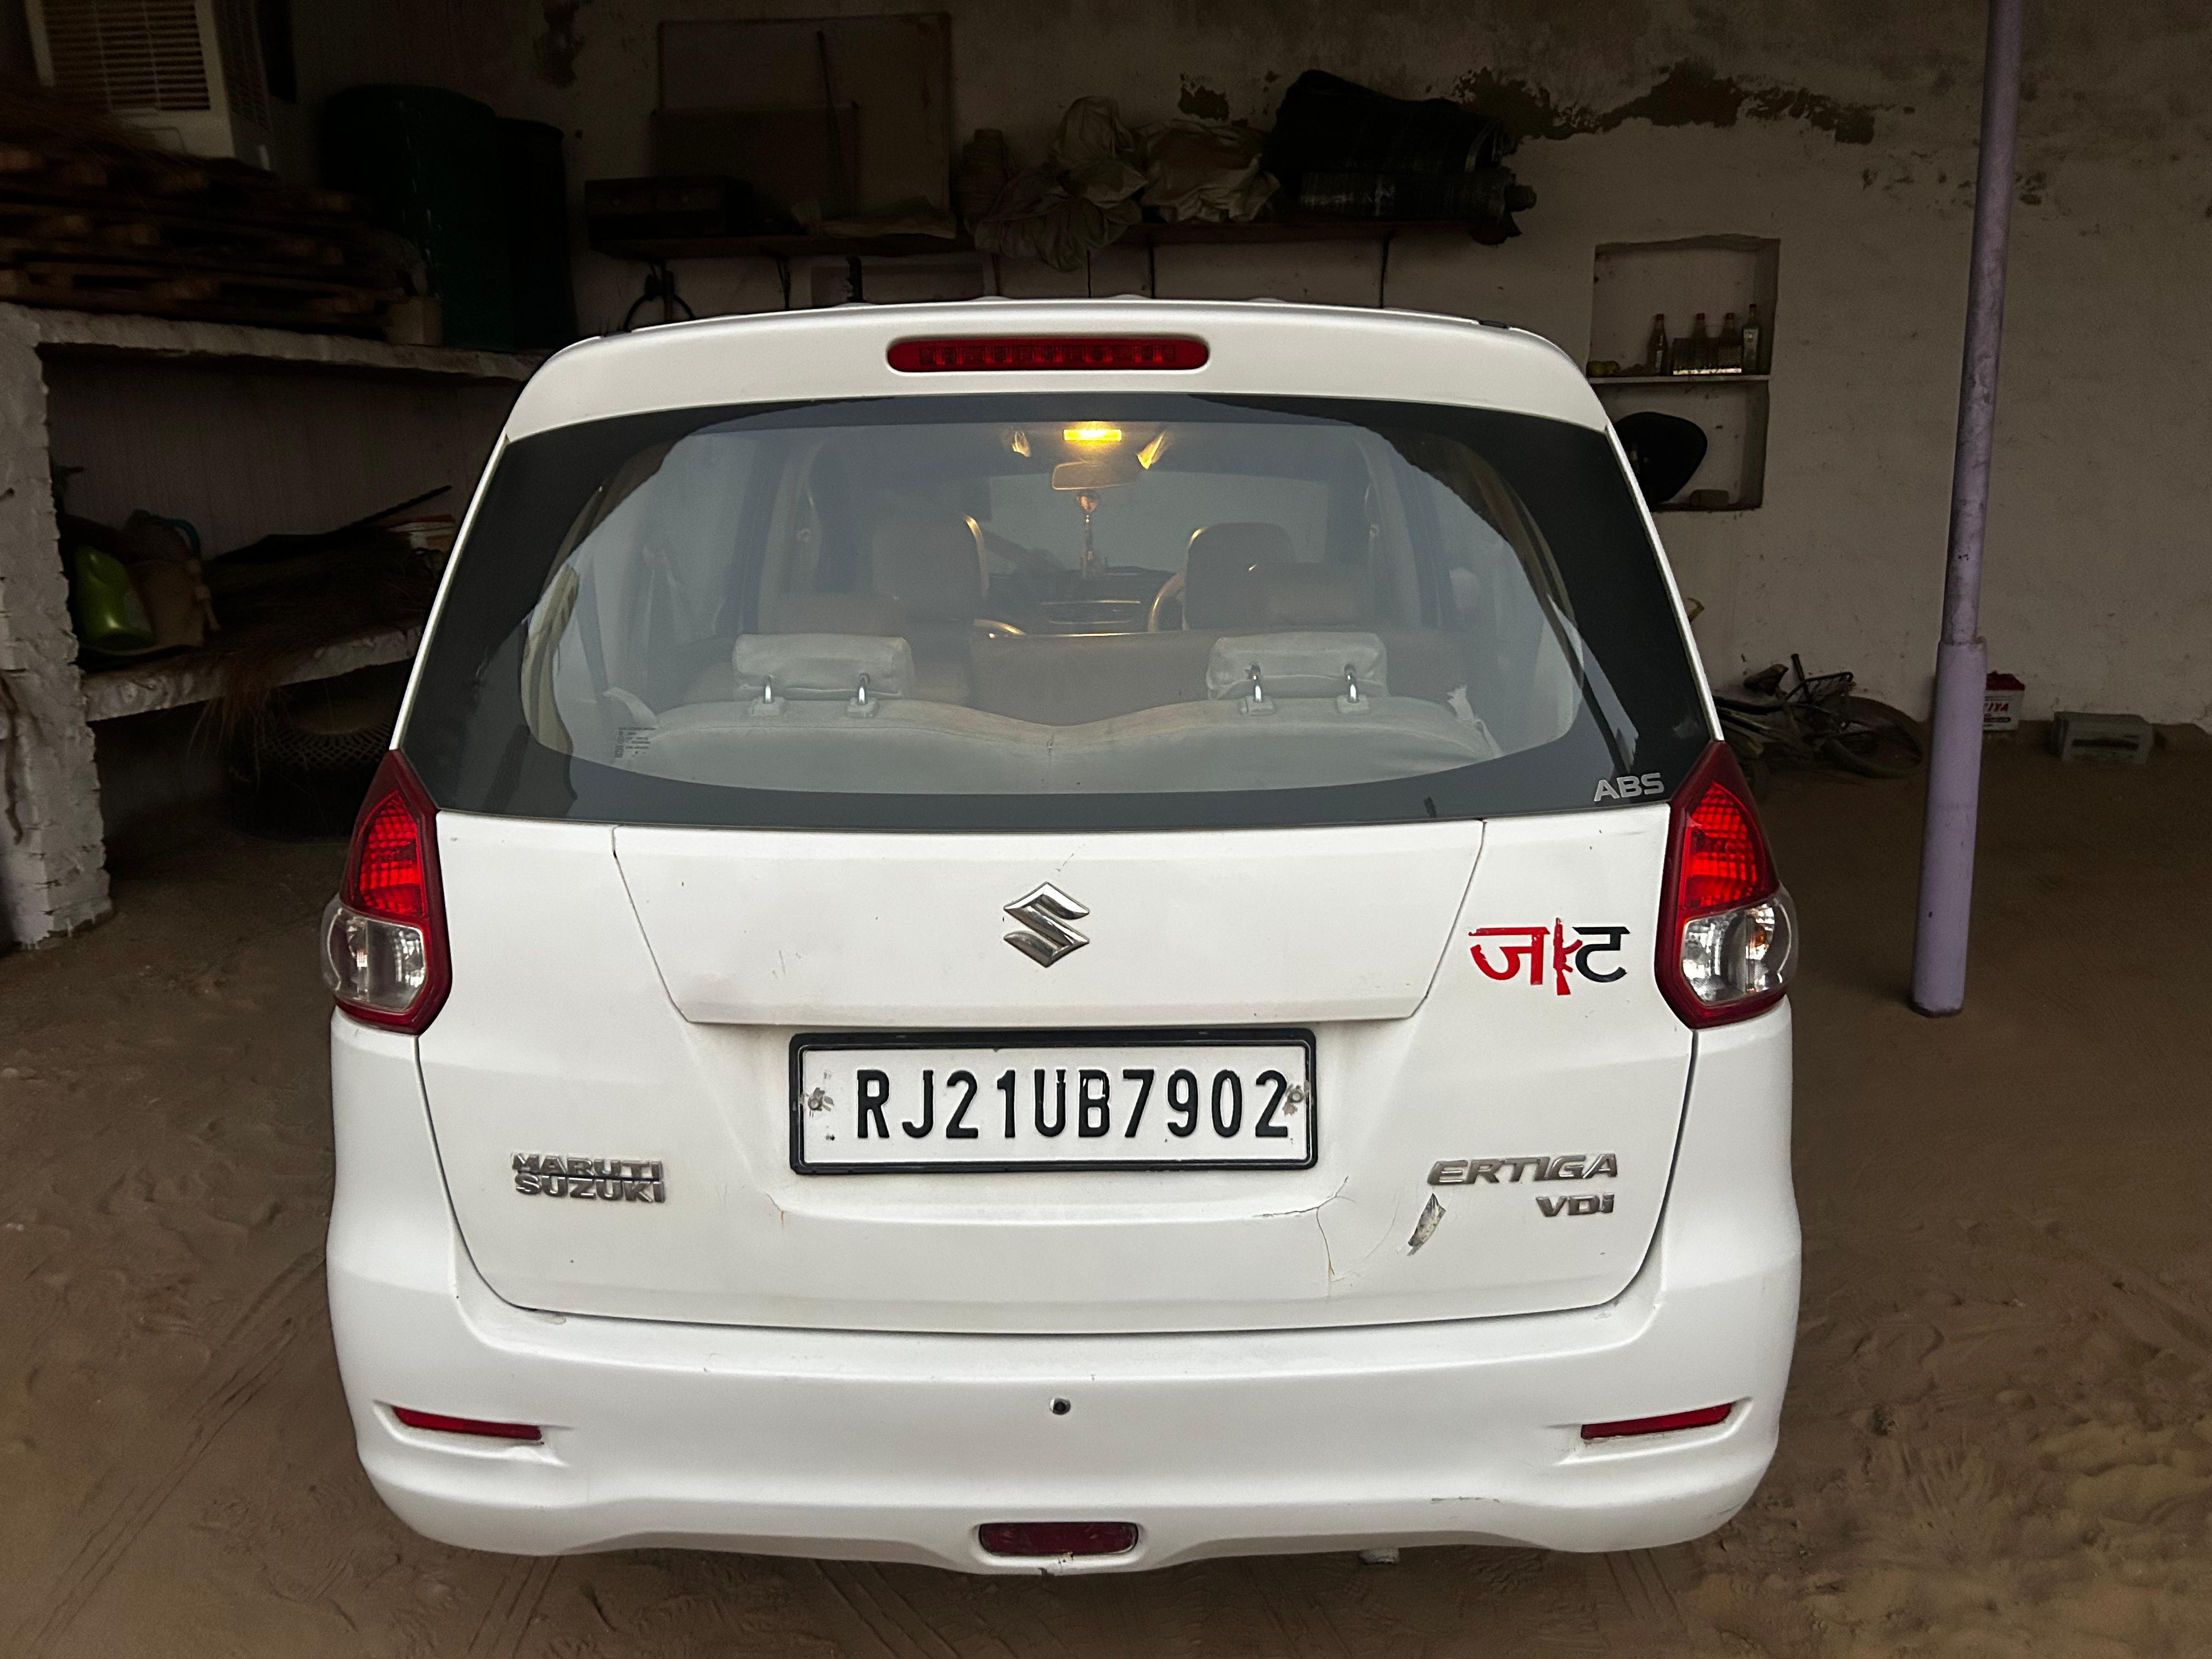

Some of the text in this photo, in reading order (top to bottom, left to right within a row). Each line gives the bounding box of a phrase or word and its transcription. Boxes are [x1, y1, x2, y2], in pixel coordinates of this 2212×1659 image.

[1594, 772, 1664, 802] ABS
[857, 1068, 1289, 1138] RJ21UB7902
[511, 1153, 664, 1181] MARUTI
[1427, 1153, 1618, 1185] ERTIGA
[515, 1173, 666, 1204] SUZUKI
